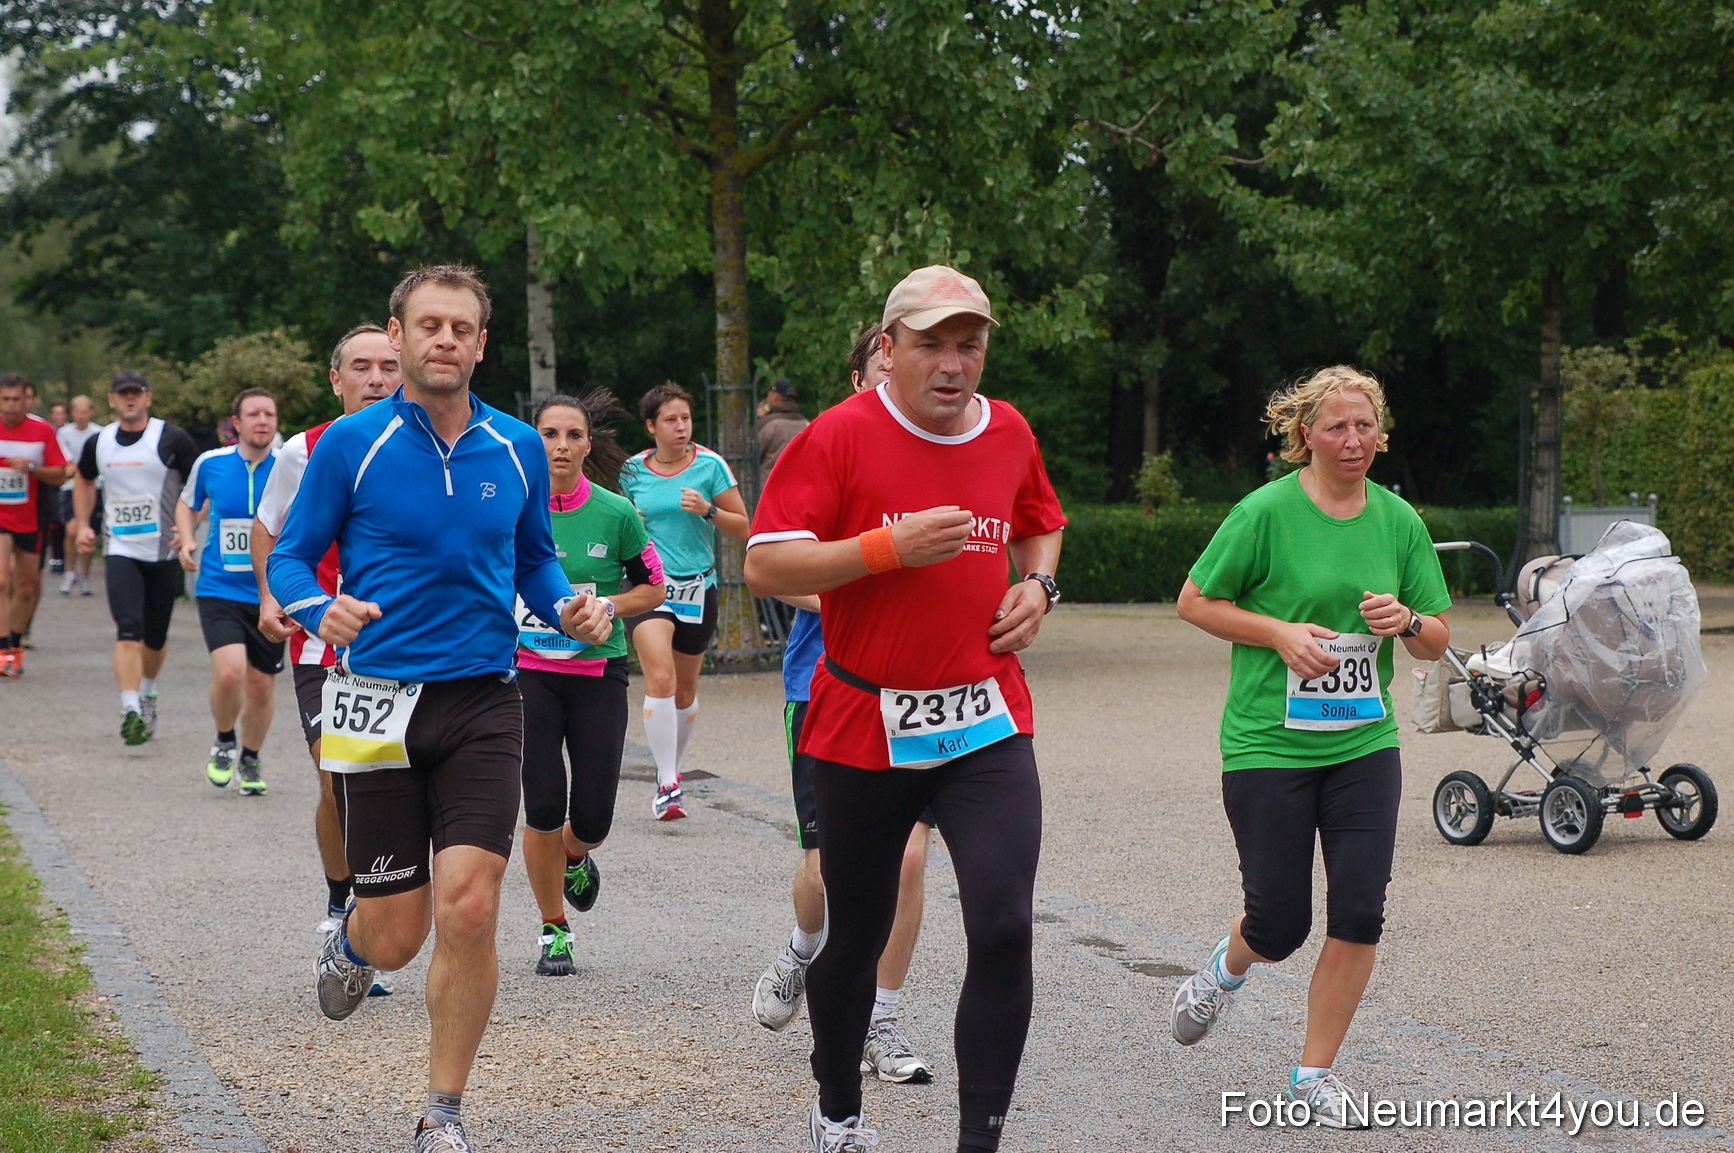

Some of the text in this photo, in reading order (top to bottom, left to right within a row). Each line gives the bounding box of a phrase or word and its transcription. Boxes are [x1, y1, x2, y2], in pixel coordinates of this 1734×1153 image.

[114, 505, 152, 523] 2692
[981, 545, 999, 554] STADT
[533, 635, 571, 648] Bettina
[1329, 643, 1366, 653] Neumarkt
[351, 677, 402, 694] Neumarkt
[332, 691, 395, 735] 552
[895, 684, 991, 731] 2375
[1321, 703, 1357, 720] Sonja
[937, 733, 969, 754] Karl
[370, 854, 394, 873] LV
[355, 868, 416, 885] DEGGENDORF
